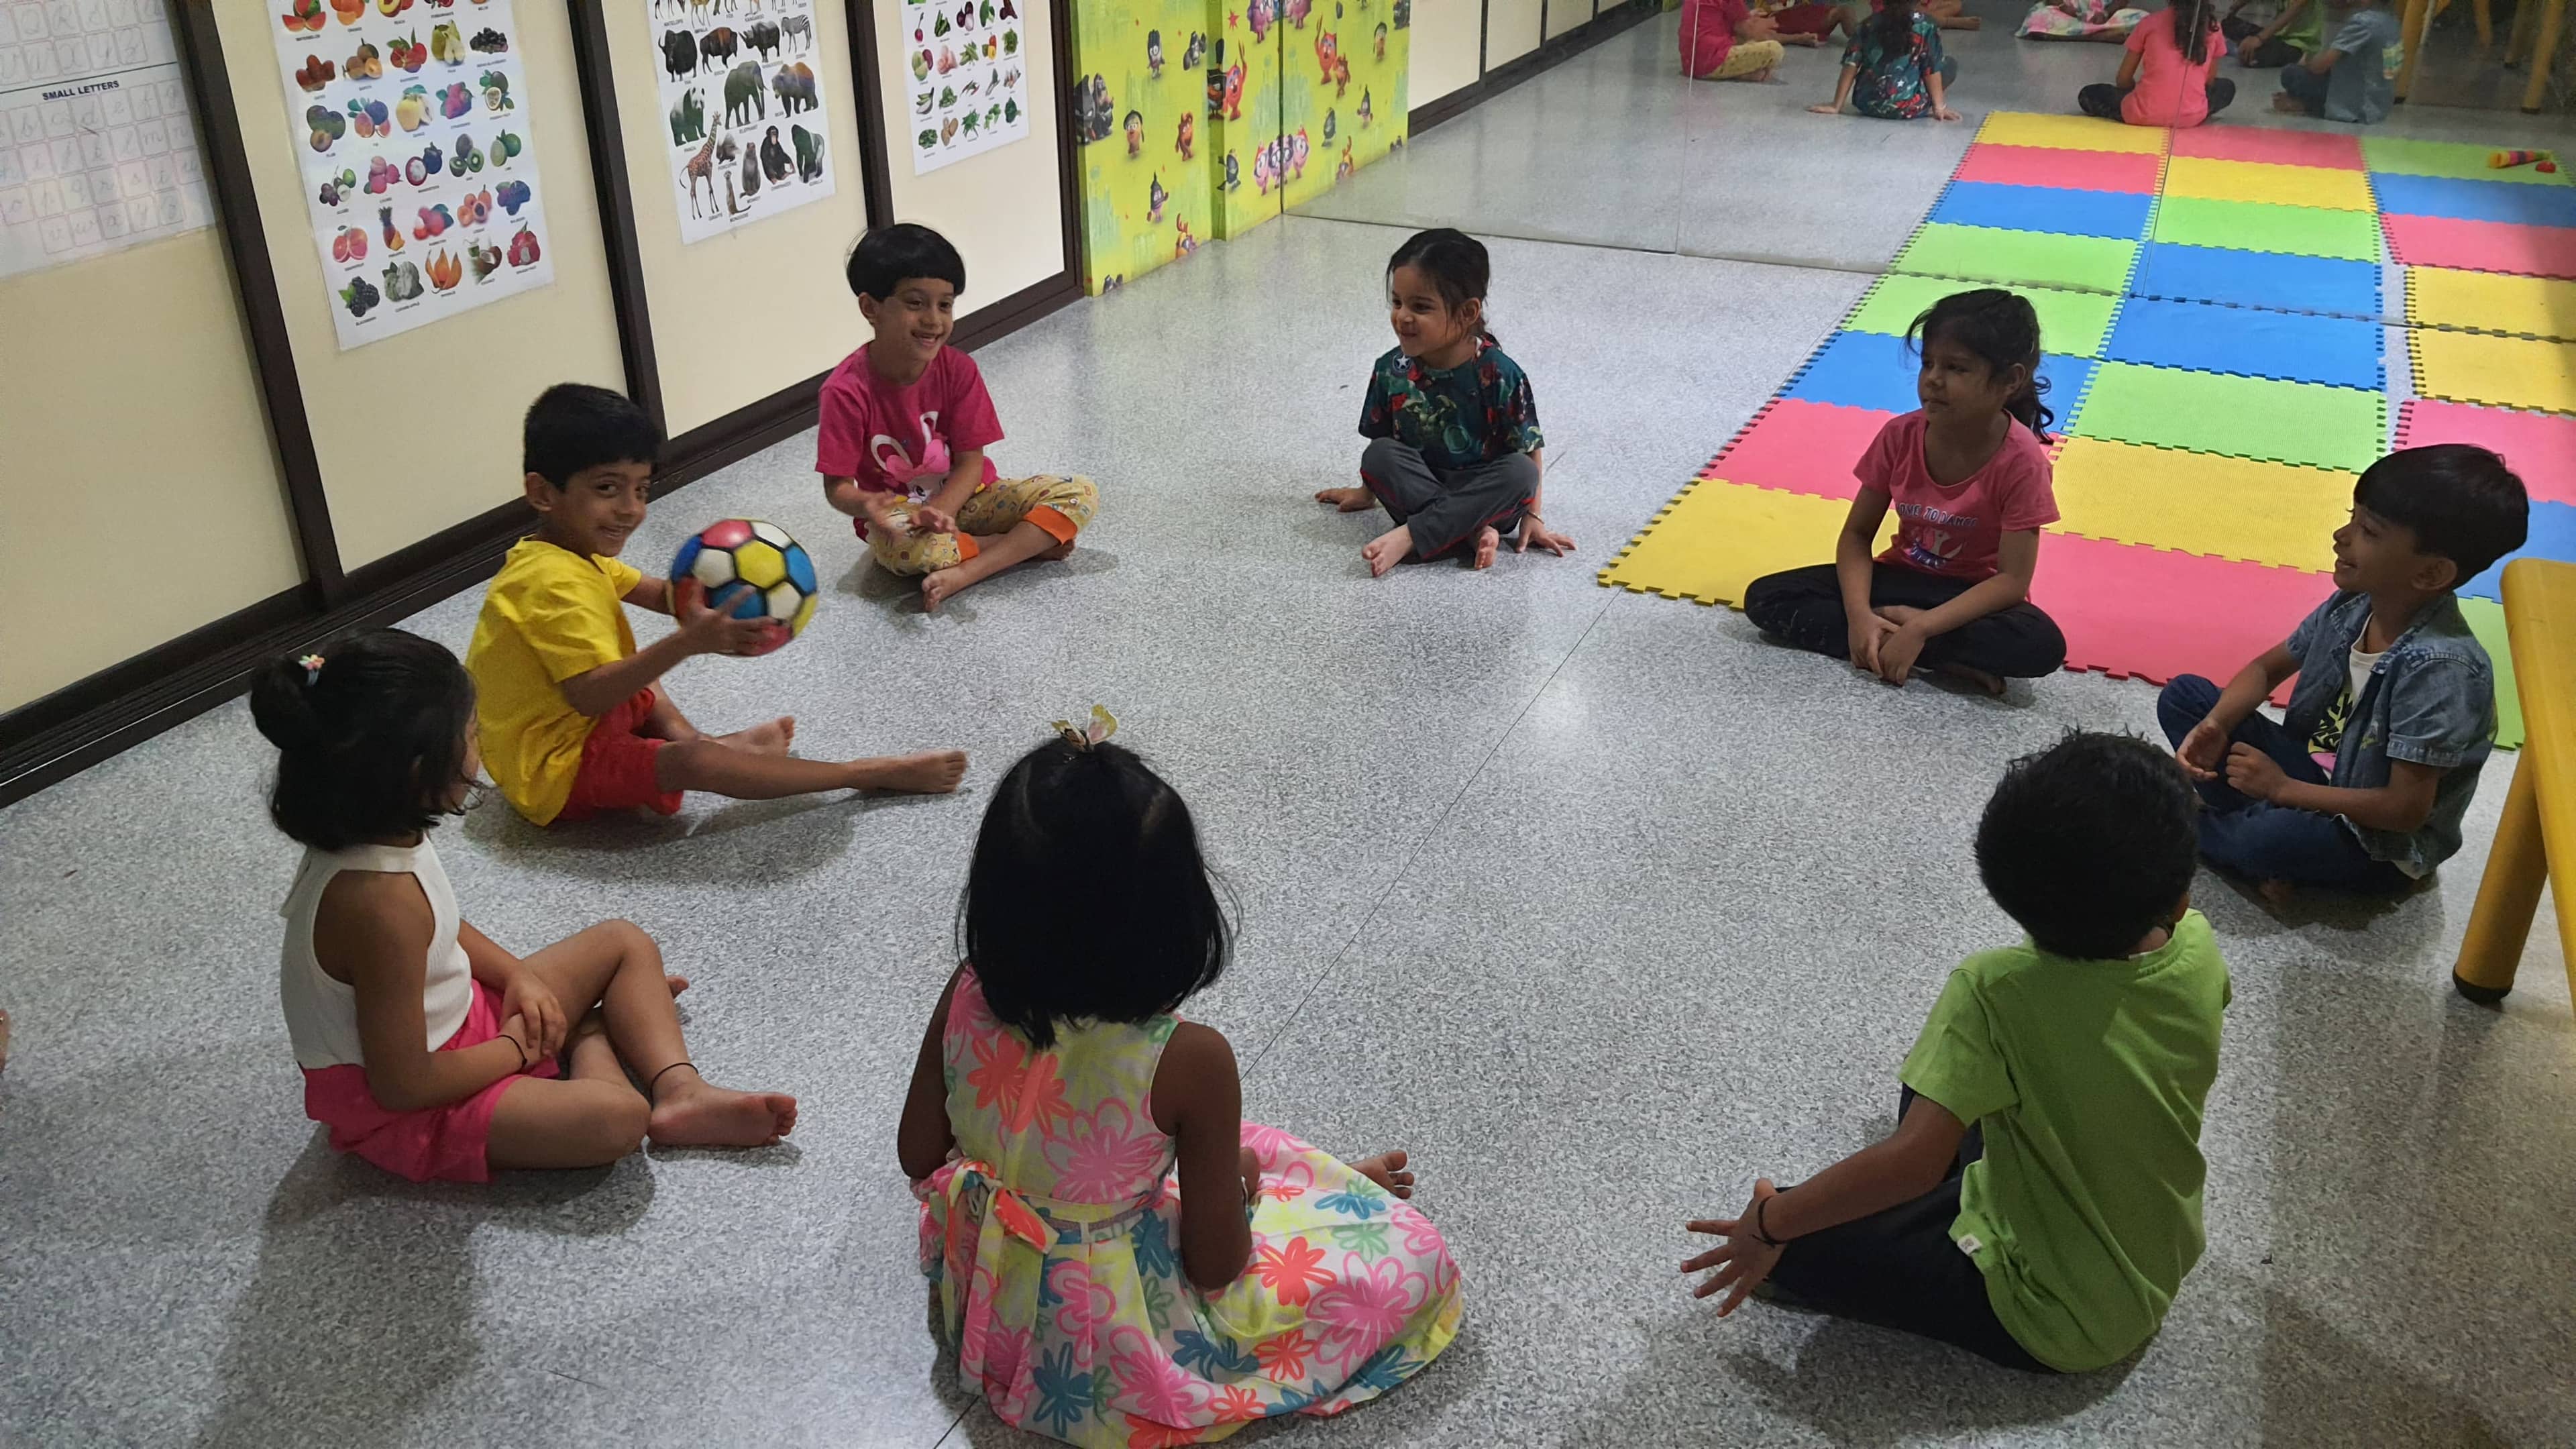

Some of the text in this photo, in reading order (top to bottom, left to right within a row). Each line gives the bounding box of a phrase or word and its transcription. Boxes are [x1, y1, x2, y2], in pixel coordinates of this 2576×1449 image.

[42, 80, 119, 100] SMALL LETTERS
[1923, 506, 1939, 521] TO
